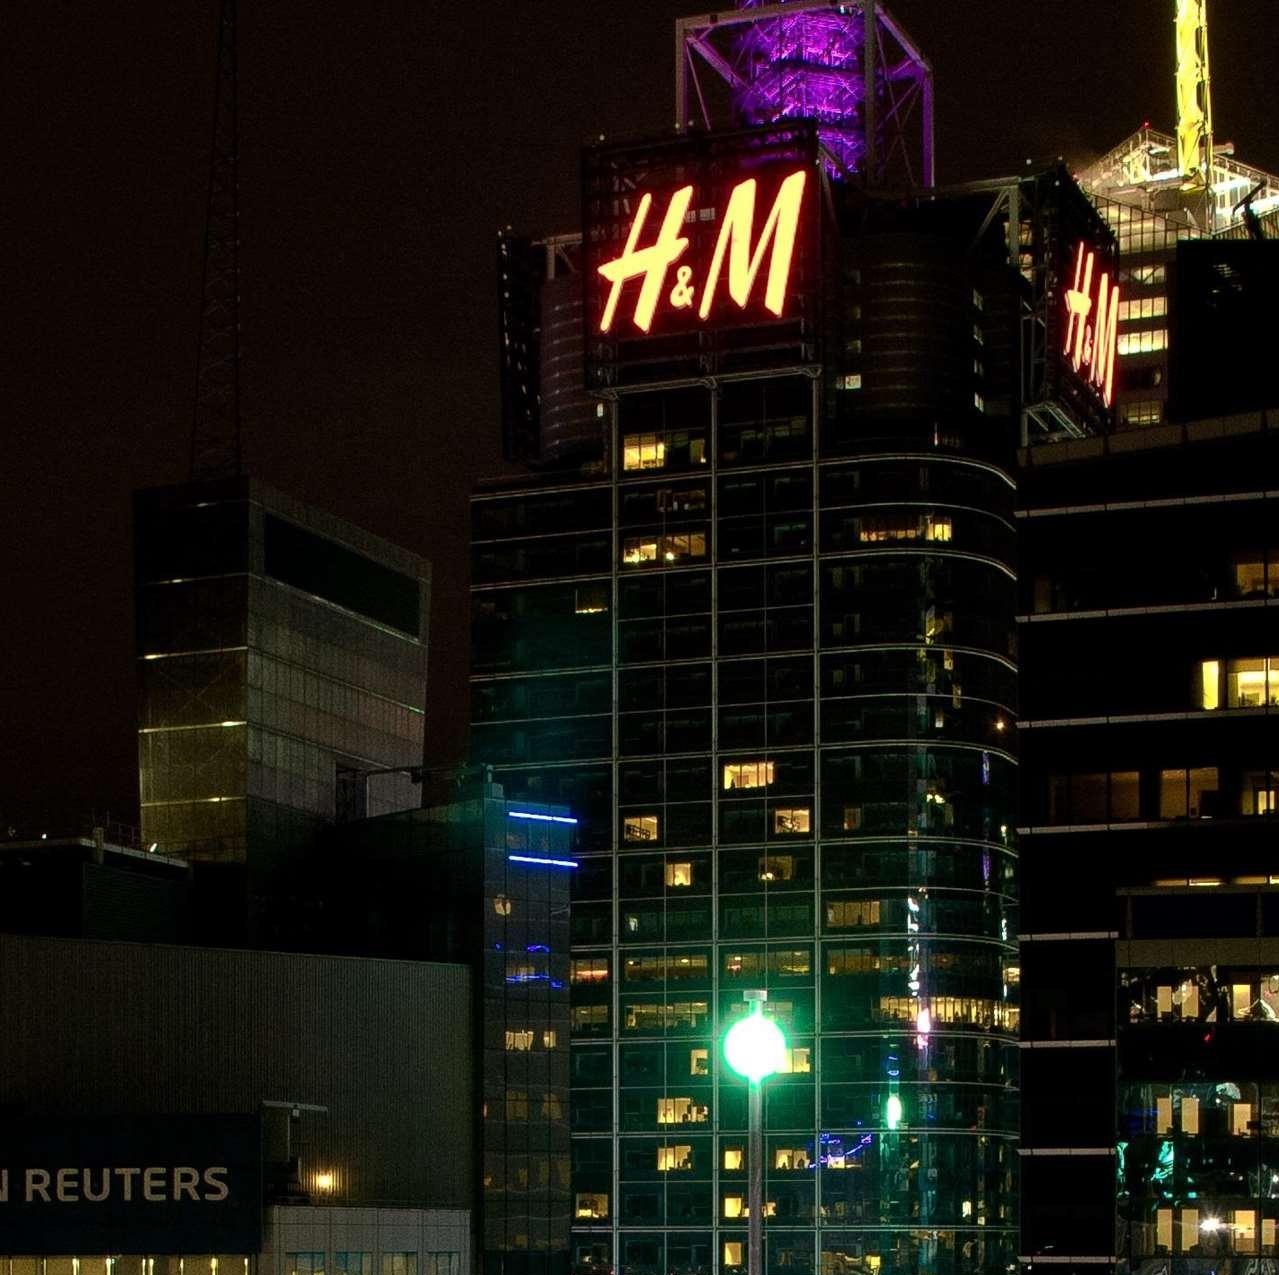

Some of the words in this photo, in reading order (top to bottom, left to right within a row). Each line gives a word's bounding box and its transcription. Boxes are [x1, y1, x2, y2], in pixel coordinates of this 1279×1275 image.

[597, 170, 807, 333] H&M
[1063, 240, 1119, 408] H&M
[25, 1167, 230, 1203] REUTERS
